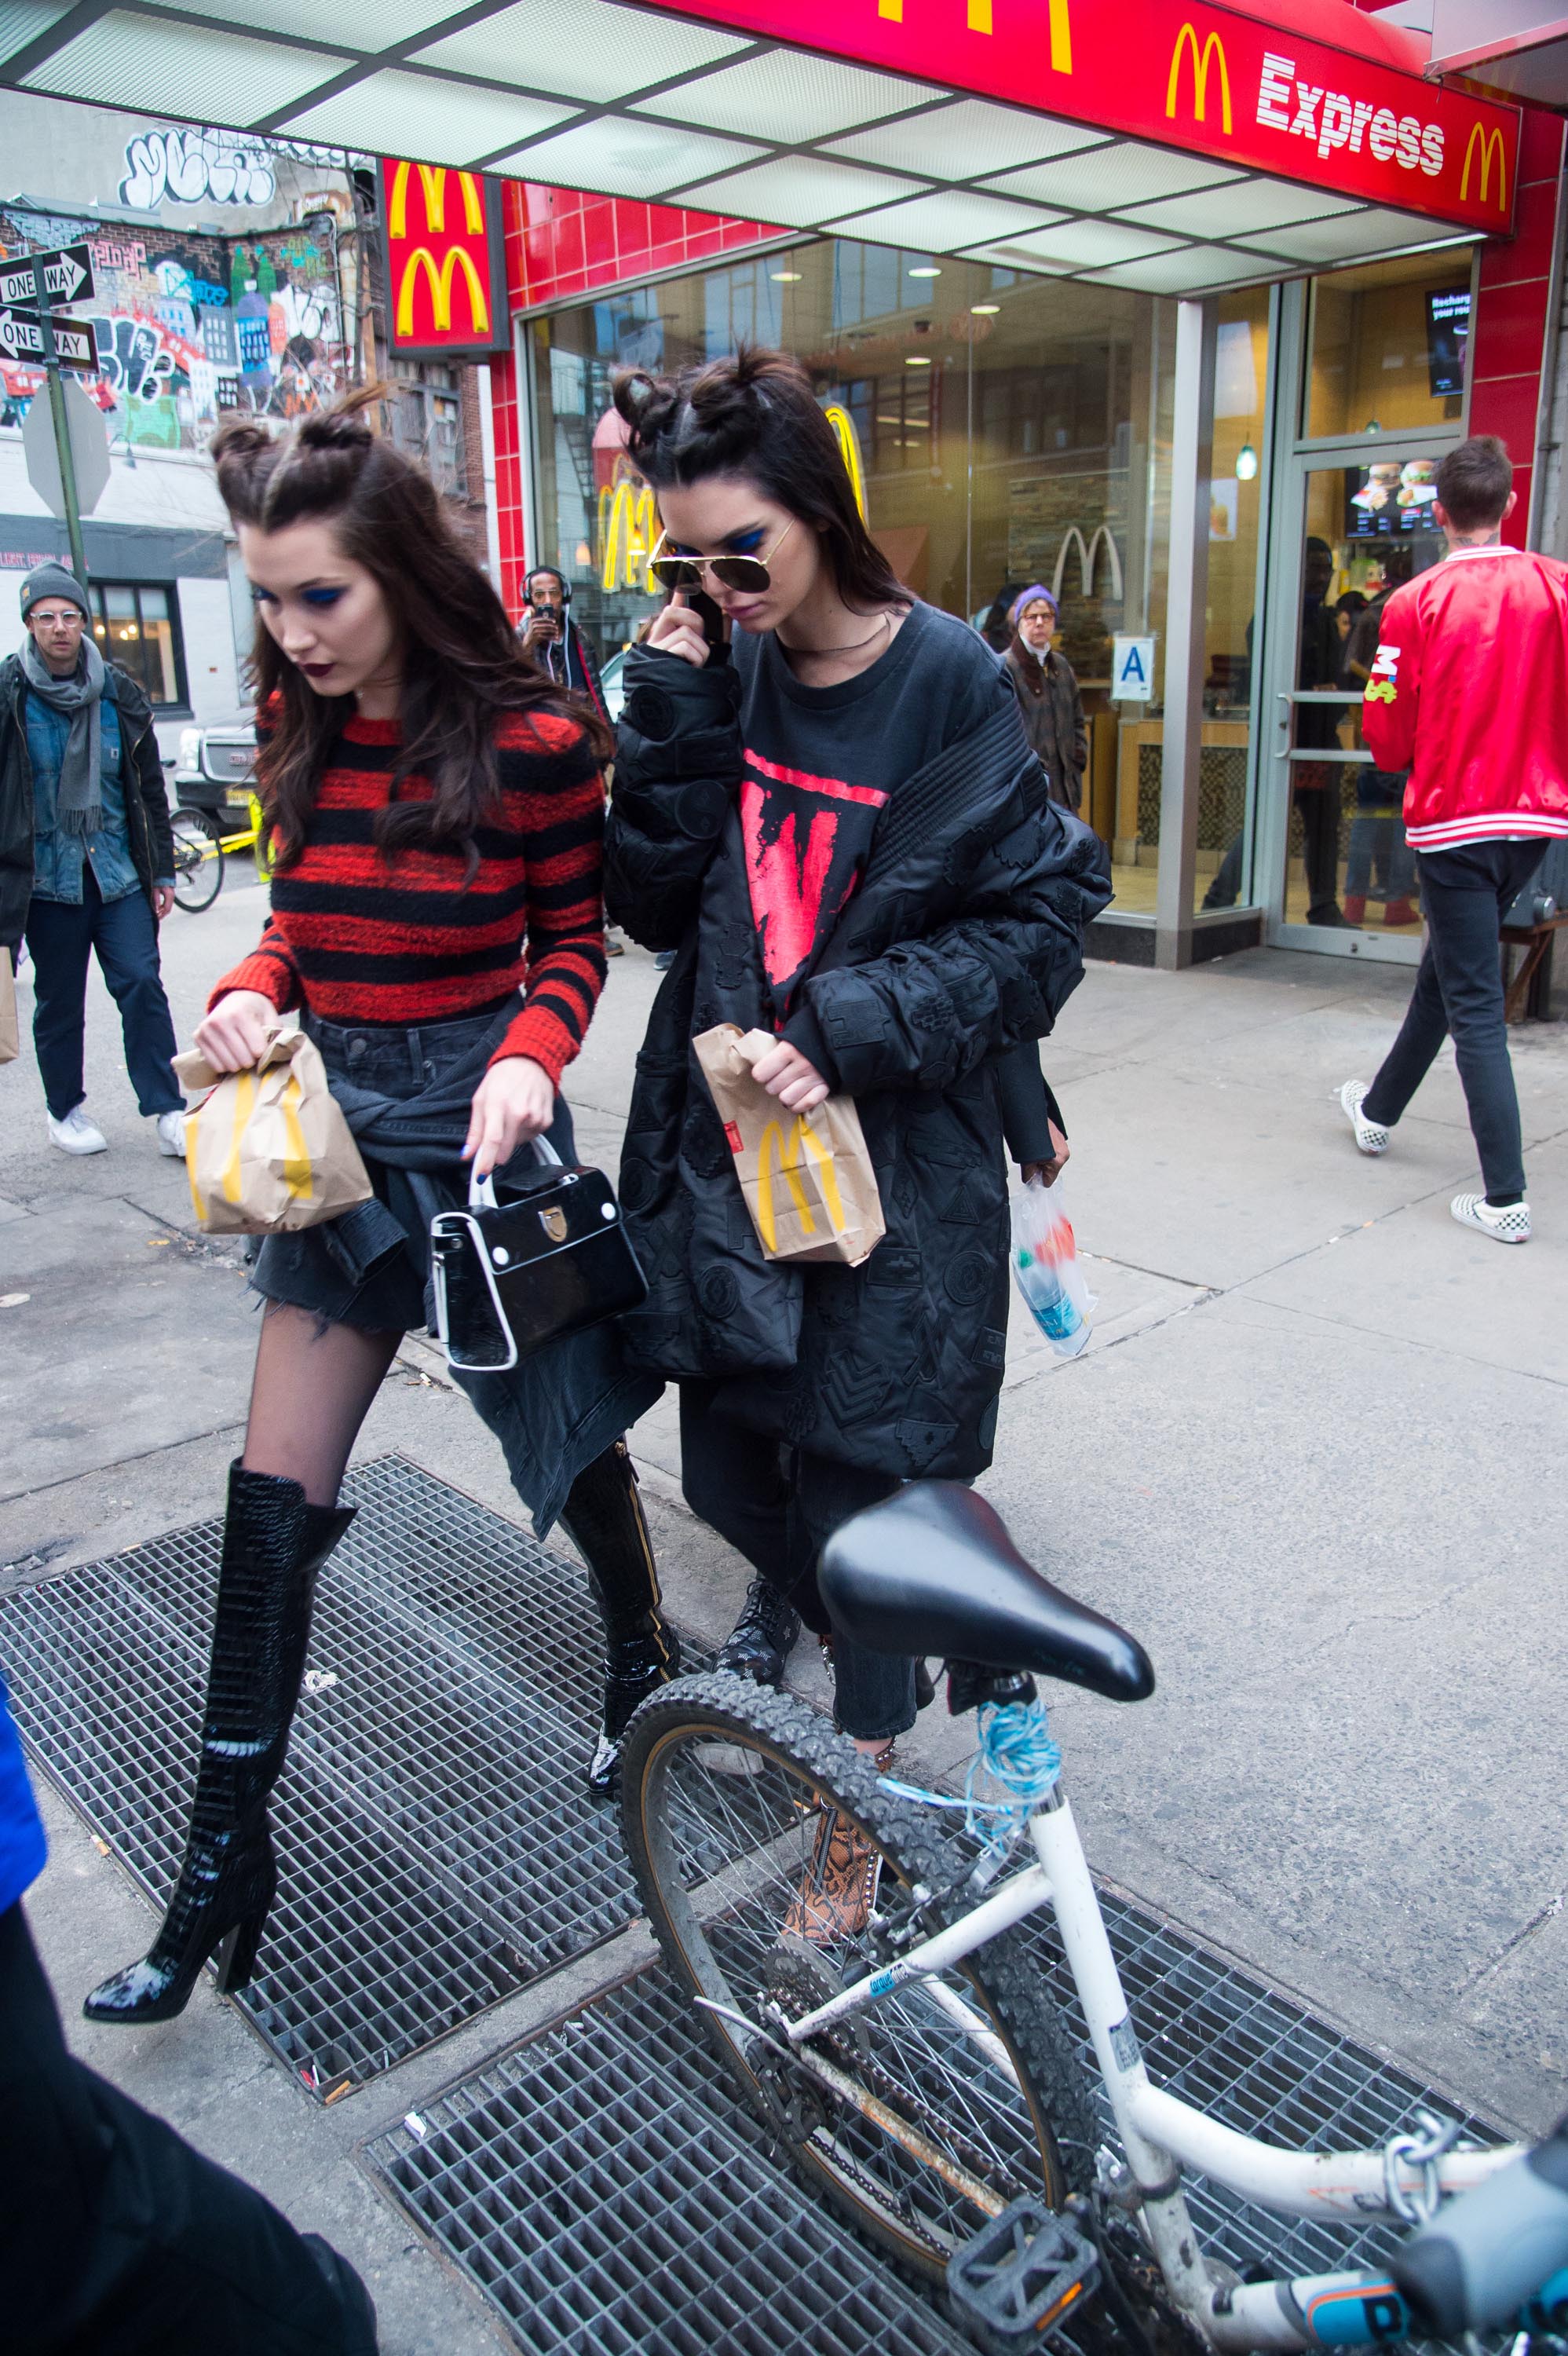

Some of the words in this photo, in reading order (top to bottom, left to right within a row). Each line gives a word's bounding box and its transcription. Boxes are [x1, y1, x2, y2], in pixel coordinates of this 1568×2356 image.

[1256, 52, 1445, 177] Express
[8, 274, 36, 298] ONE
[46, 265, 75, 290] WAY
[4, 324, 39, 347] ONE
[1120, 646, 1145, 682] A
